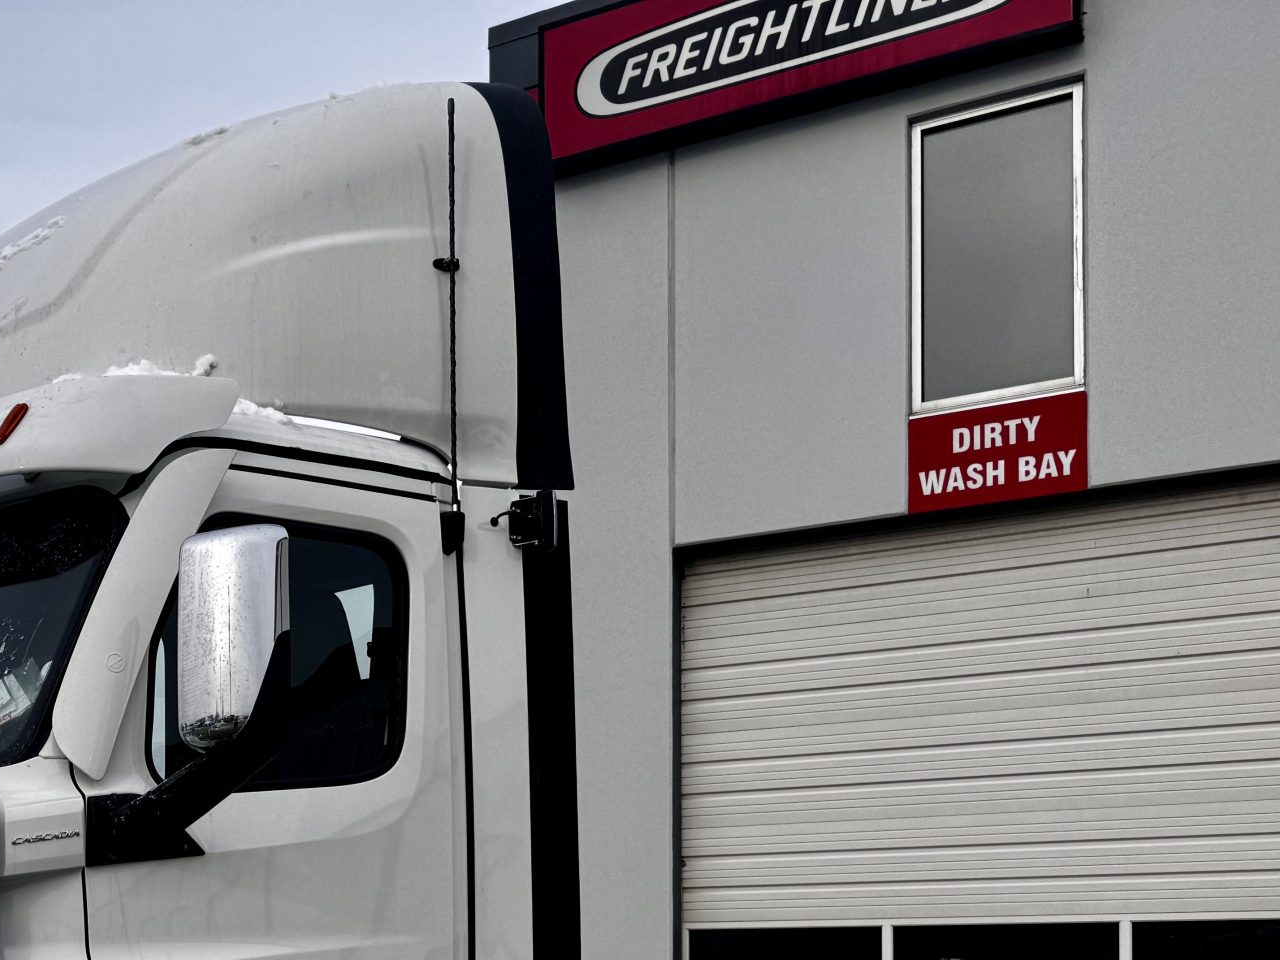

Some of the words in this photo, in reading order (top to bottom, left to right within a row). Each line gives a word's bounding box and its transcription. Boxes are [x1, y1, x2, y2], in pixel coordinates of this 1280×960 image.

[617, 0, 953, 95] FREIGHTLI
[952, 415, 1041, 454] DIRTY
[918, 459, 1005, 496] WASH
[1018, 449, 1077, 483] BAY
[11, 829, 80, 845] CASCADIA
